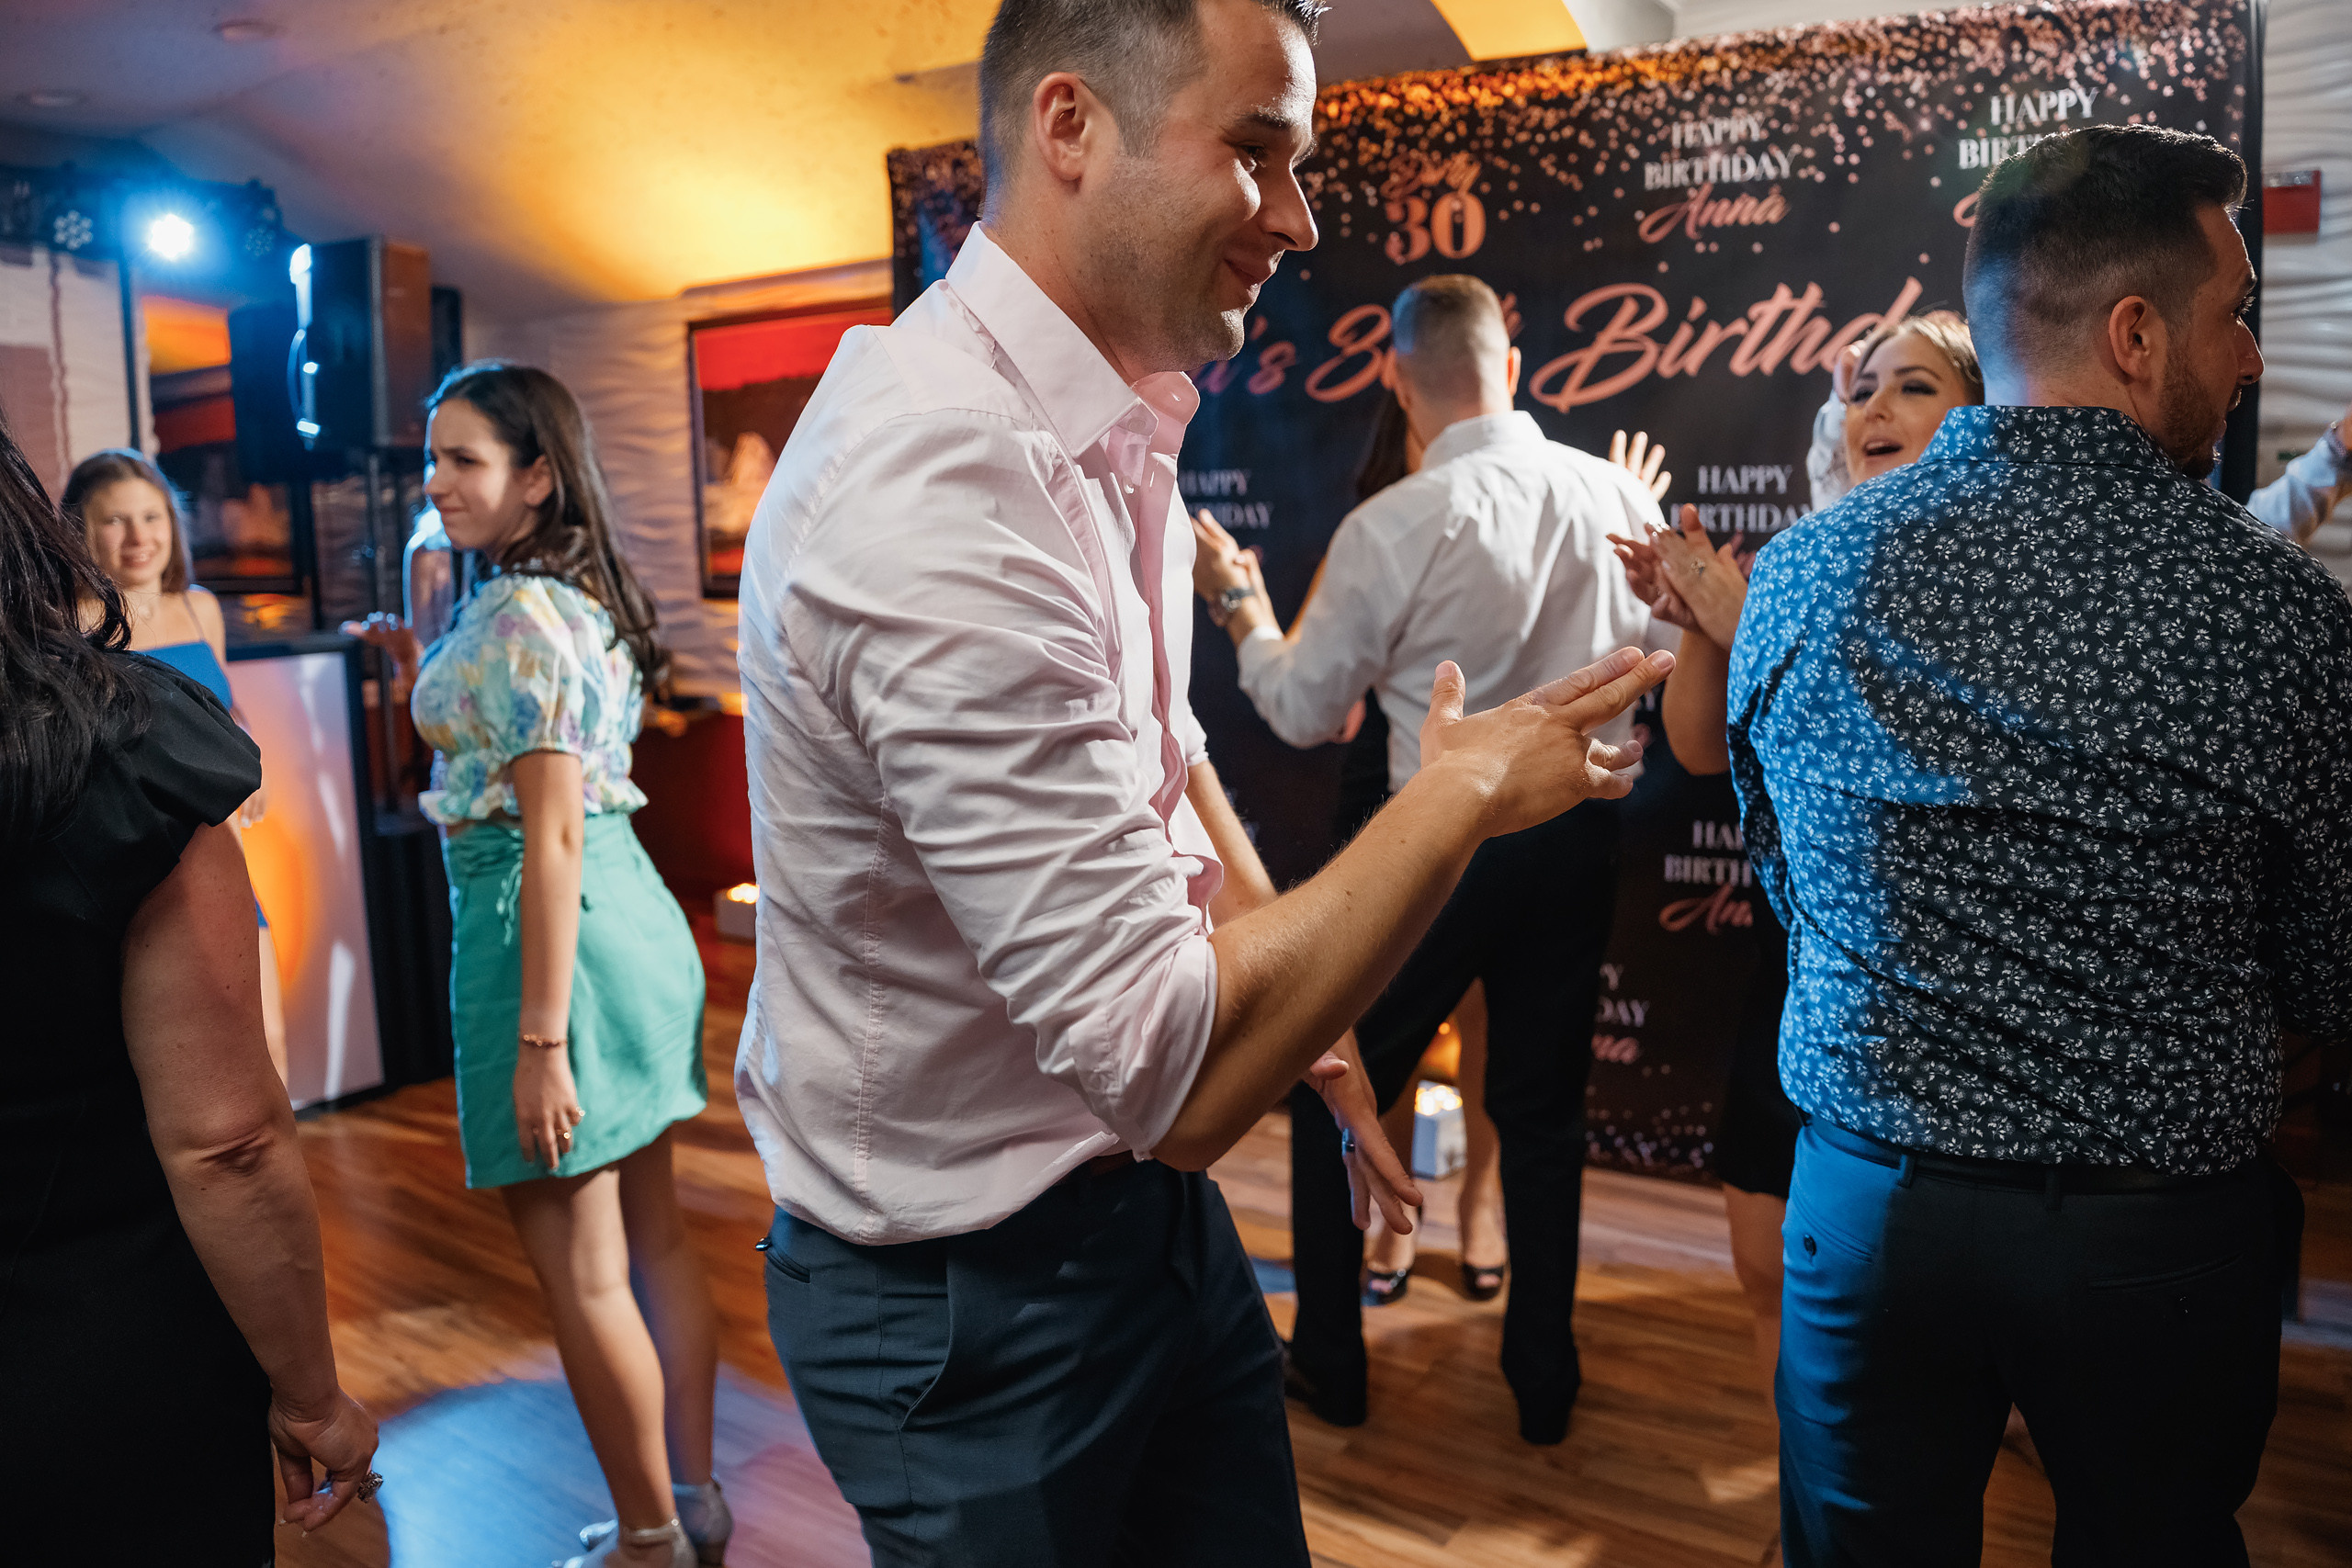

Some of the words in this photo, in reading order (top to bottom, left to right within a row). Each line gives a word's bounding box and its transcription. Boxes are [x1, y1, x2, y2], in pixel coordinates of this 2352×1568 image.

[1990, 85, 2099, 127] HAPPY
[1671, 114, 1766, 149] HAPPY
[1644, 144, 1802, 191] BIRTHDAY
[1385, 190, 1487, 264] 30
[1638, 182, 1790, 243] Anna
[1529, 276, 1924, 413] Birthd
[1698, 465, 1792, 494] HAPPY
[1664, 854, 1752, 888] BIRTH
